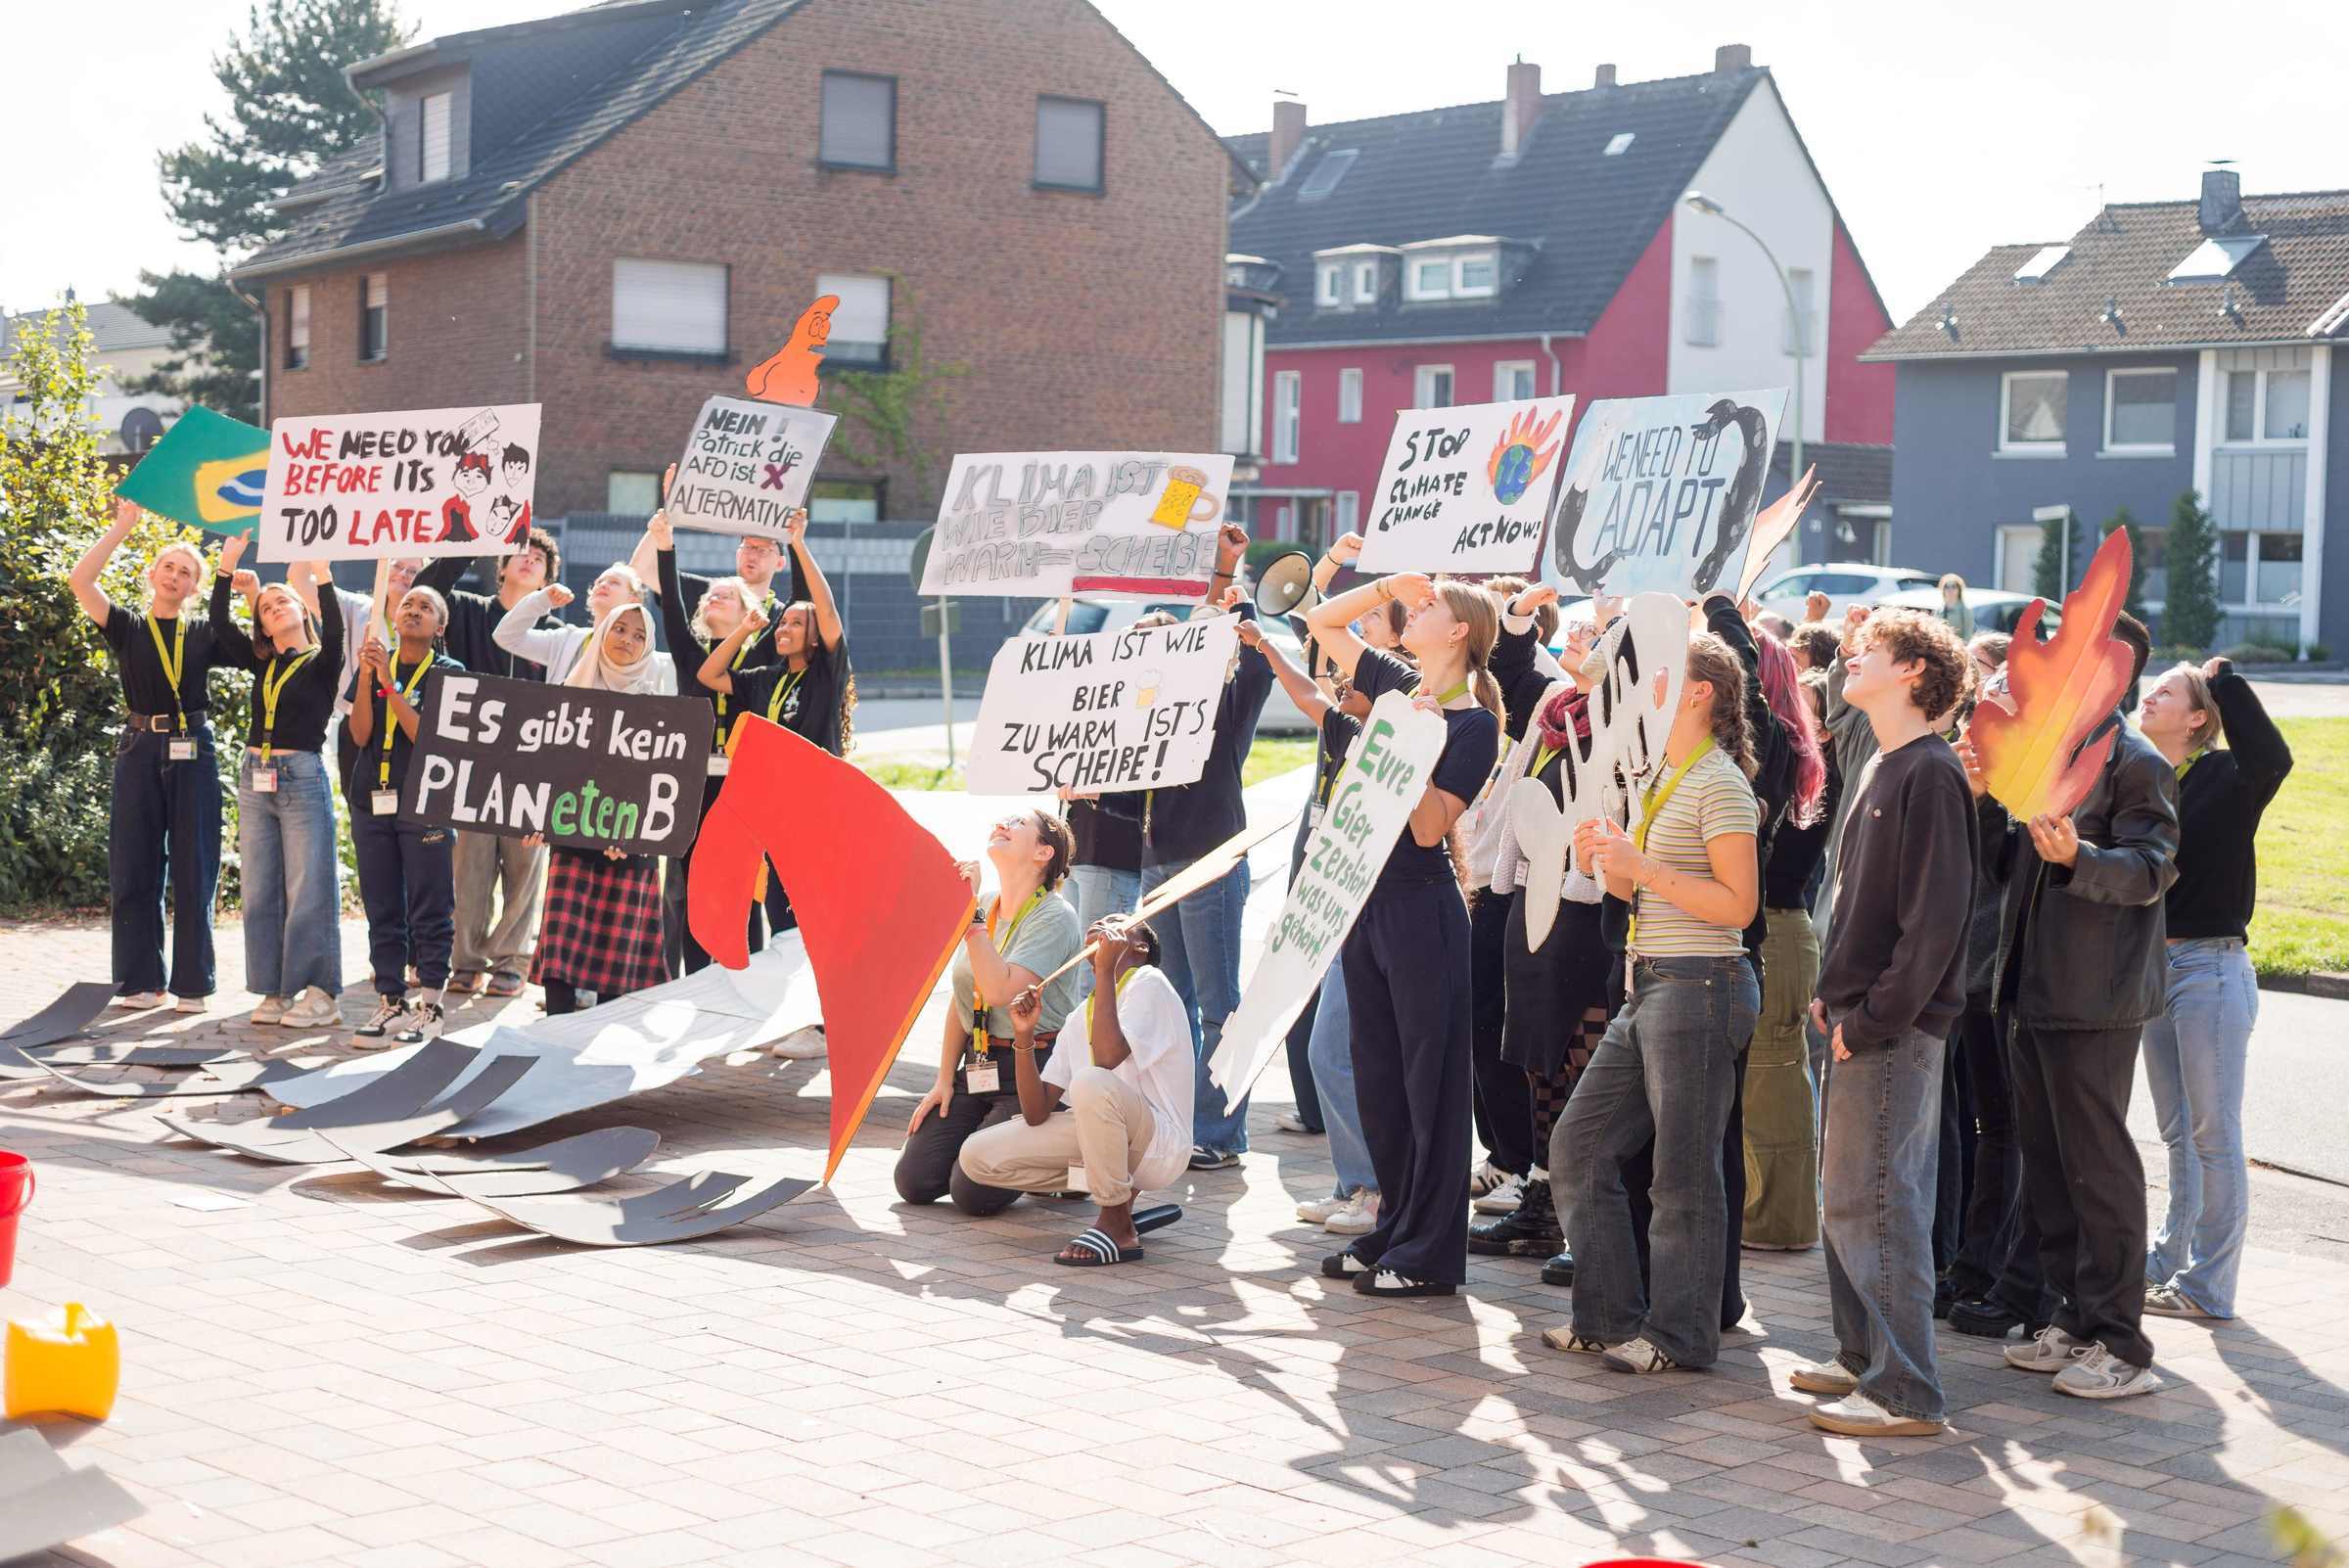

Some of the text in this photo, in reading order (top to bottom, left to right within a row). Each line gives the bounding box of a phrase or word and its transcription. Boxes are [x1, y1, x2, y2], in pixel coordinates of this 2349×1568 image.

[282, 428, 335, 460] WE
[339, 428, 419, 459] NEED
[692, 431, 803, 467] Patrick die
[1398, 428, 1470, 472] STOP
[1601, 424, 1722, 483] WE NEED TO
[283, 462, 383, 497] BEFORE
[730, 462, 757, 484] ist
[951, 461, 1168, 511] KLIMA IST
[281, 503, 433, 546] TOO LATE
[669, 484, 796, 530] ALTERNATIVE
[942, 500, 1104, 551] WIE BIER
[1378, 498, 1443, 531] CHANGE
[1593, 478, 1727, 558] ADAPT
[1451, 515, 1542, 554] ACT NOW!
[1020, 625, 1209, 673] KLIMA IST WIE
[1073, 680, 1125, 712] BIER
[517, 702, 593, 753] gibt
[608, 710, 687, 761] kein
[1001, 699, 1208, 754] ZU WARM IST'S
[1356, 718, 1415, 797] Eure
[640, 772, 679, 842] B
[1332, 781, 1375, 849] Gier
[1296, 876, 1350, 938] was uns
